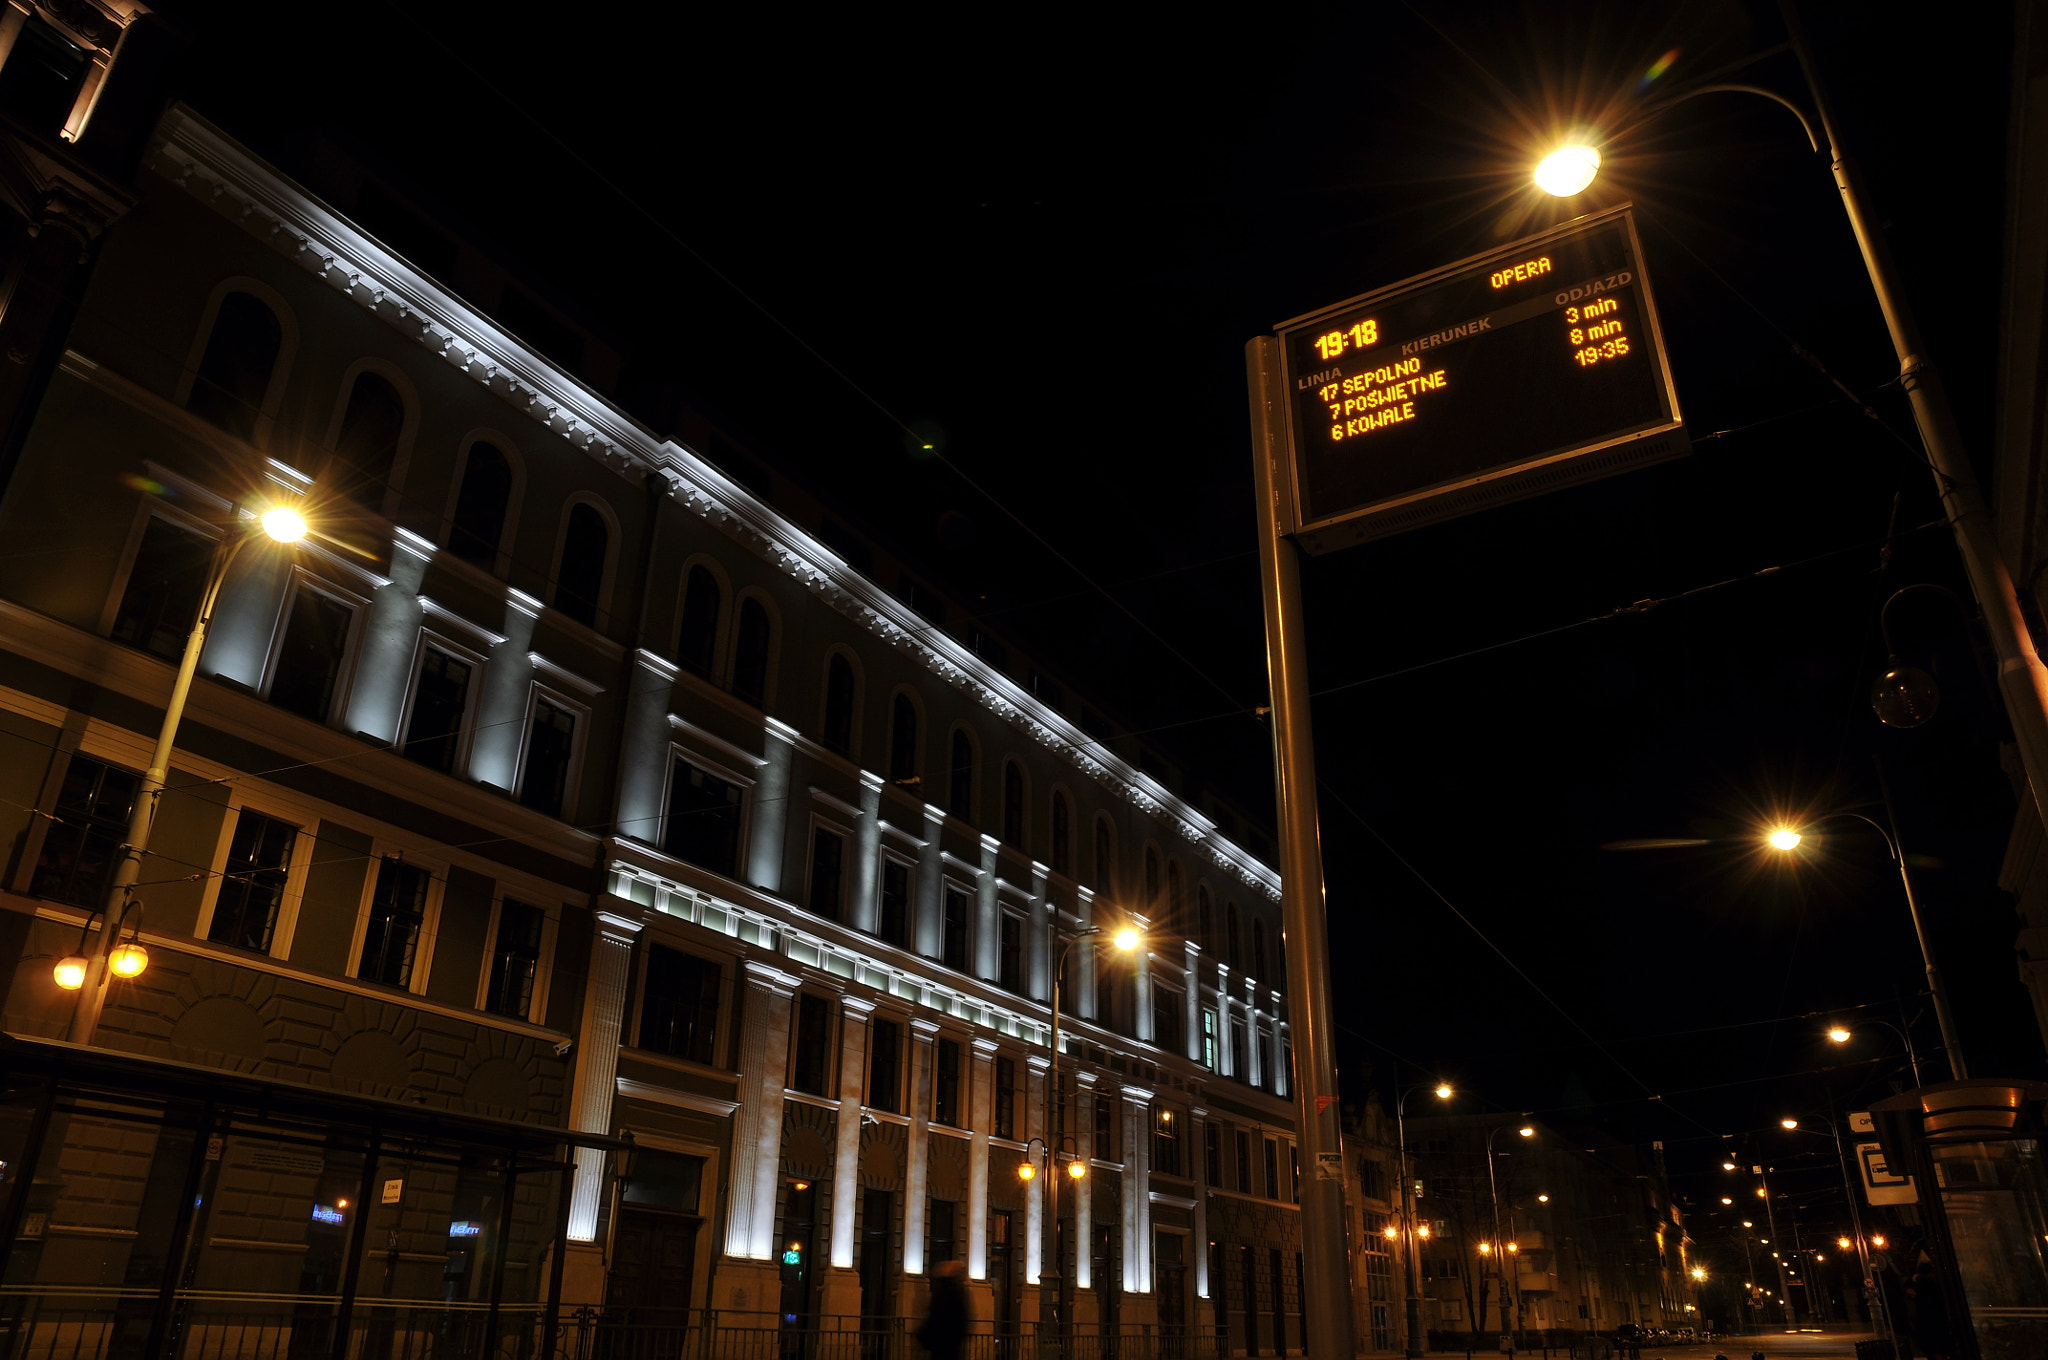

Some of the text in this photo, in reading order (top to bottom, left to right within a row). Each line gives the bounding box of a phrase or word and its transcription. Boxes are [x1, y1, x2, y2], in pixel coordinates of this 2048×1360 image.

[1490, 257, 1552, 289] OPERA
[1555, 271, 1632, 305] ODJAZD
[1565, 298, 1617, 323] 3 min
[1314, 319, 1378, 360] 19:18
[1401, 317, 1492, 356] KIERUNEK
[1569, 319, 1622, 345] 8 min
[1574, 337, 1630, 367] 19:35
[1298, 367, 1342, 390] LINIA
[1319, 383, 1339, 401] 17
[1329, 403, 1341, 420] 7
[1331, 402, 1415, 441] 6 KOWALE
